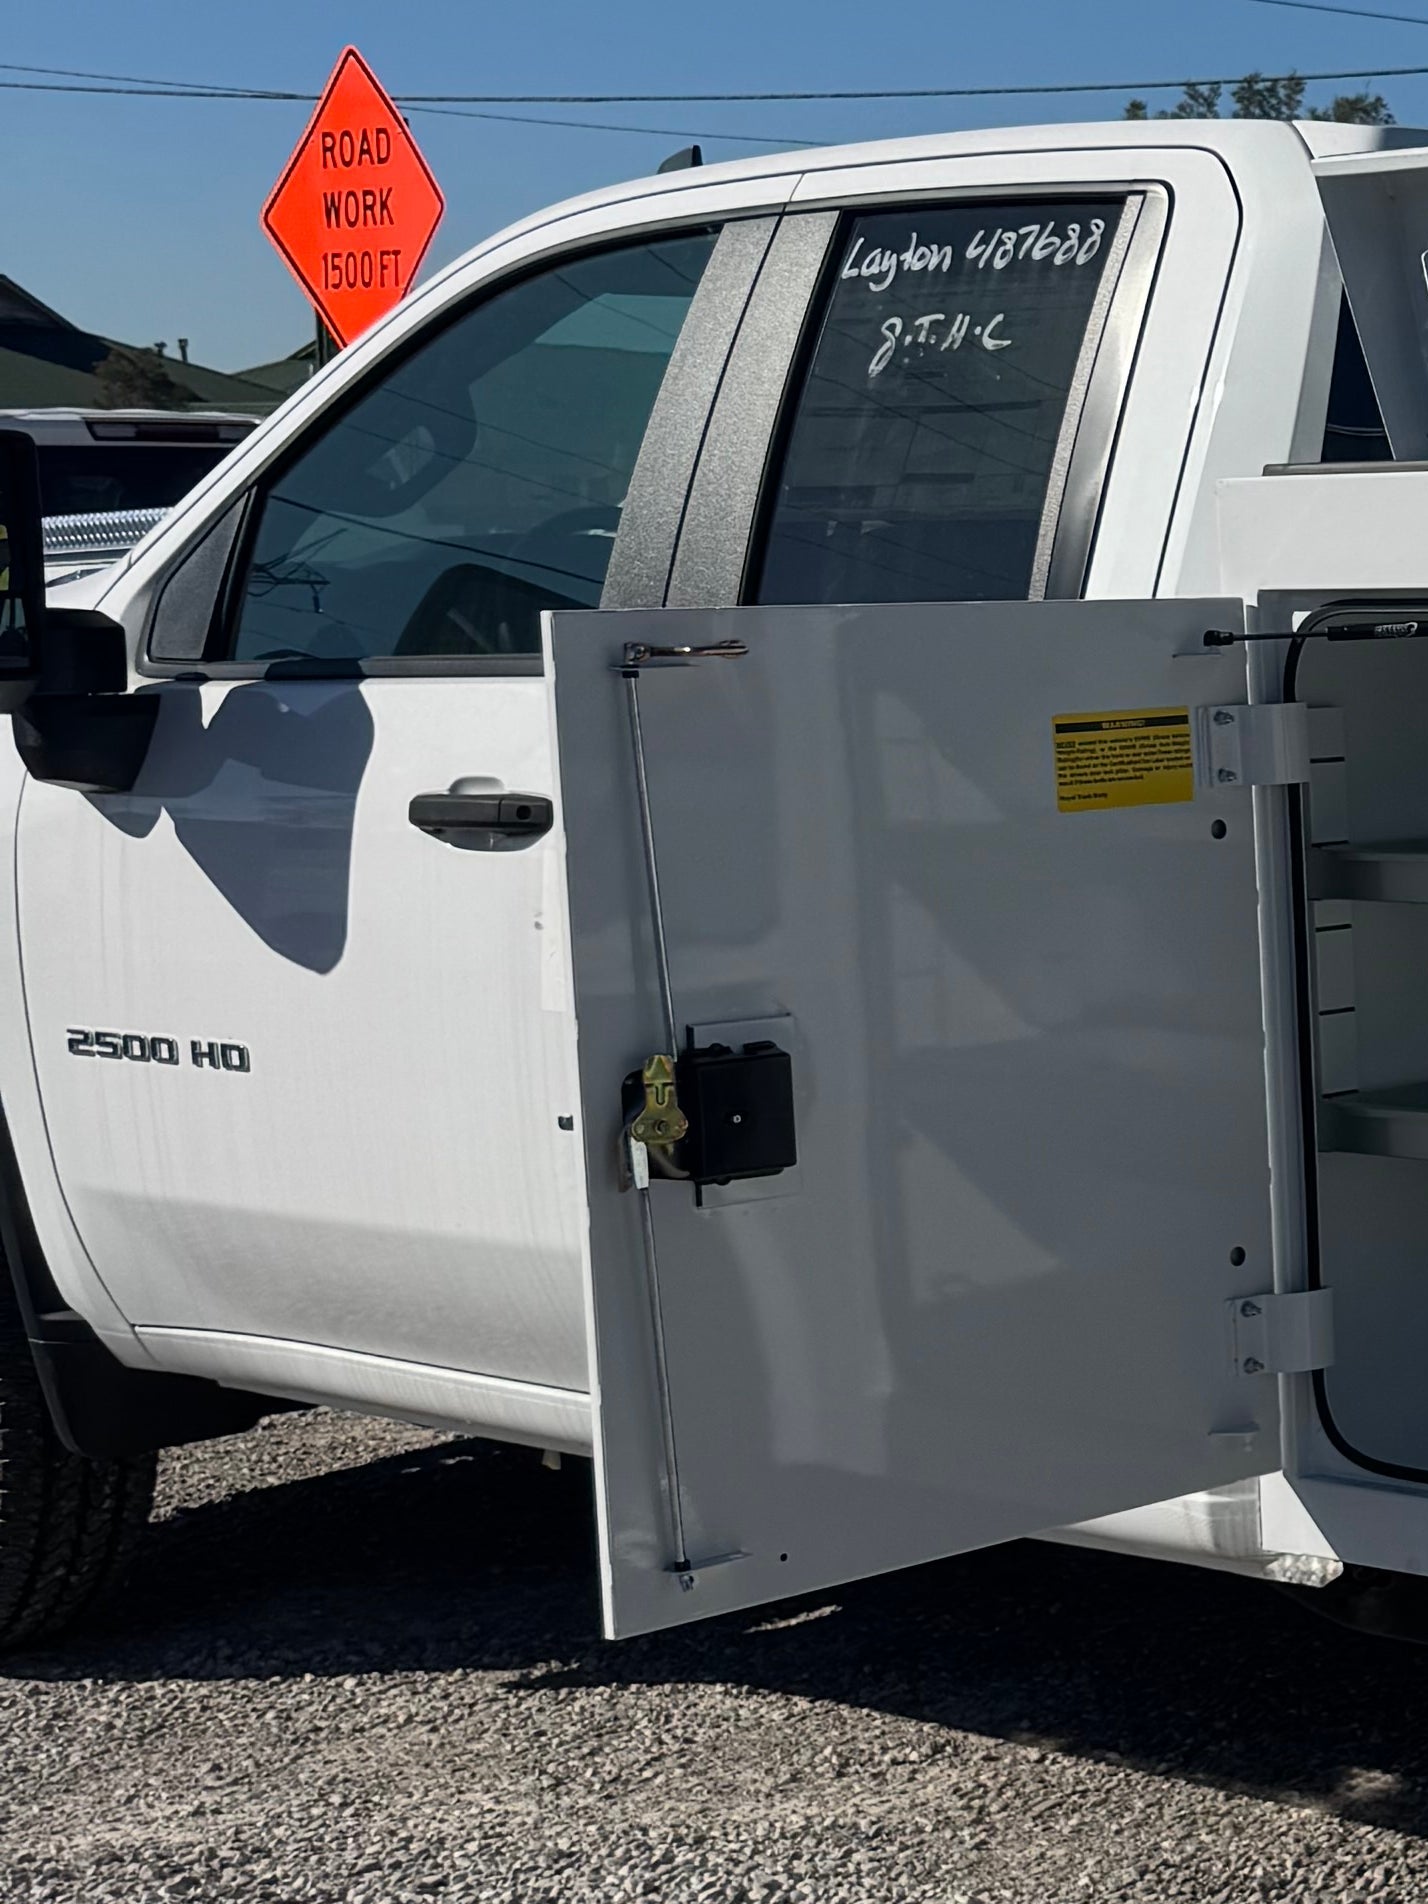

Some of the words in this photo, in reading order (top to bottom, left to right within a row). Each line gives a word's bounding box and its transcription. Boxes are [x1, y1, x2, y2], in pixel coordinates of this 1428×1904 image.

[320, 127, 391, 169] ROAD
[322, 186, 395, 228] WORK
[322, 250, 373, 290] 1500
[379, 249, 401, 288] FT
[841, 232, 953, 292] Layton
[965, 218, 1105, 270] 487688
[66, 1028, 179, 1066] 2500
[190, 1040, 250, 1073] HD
